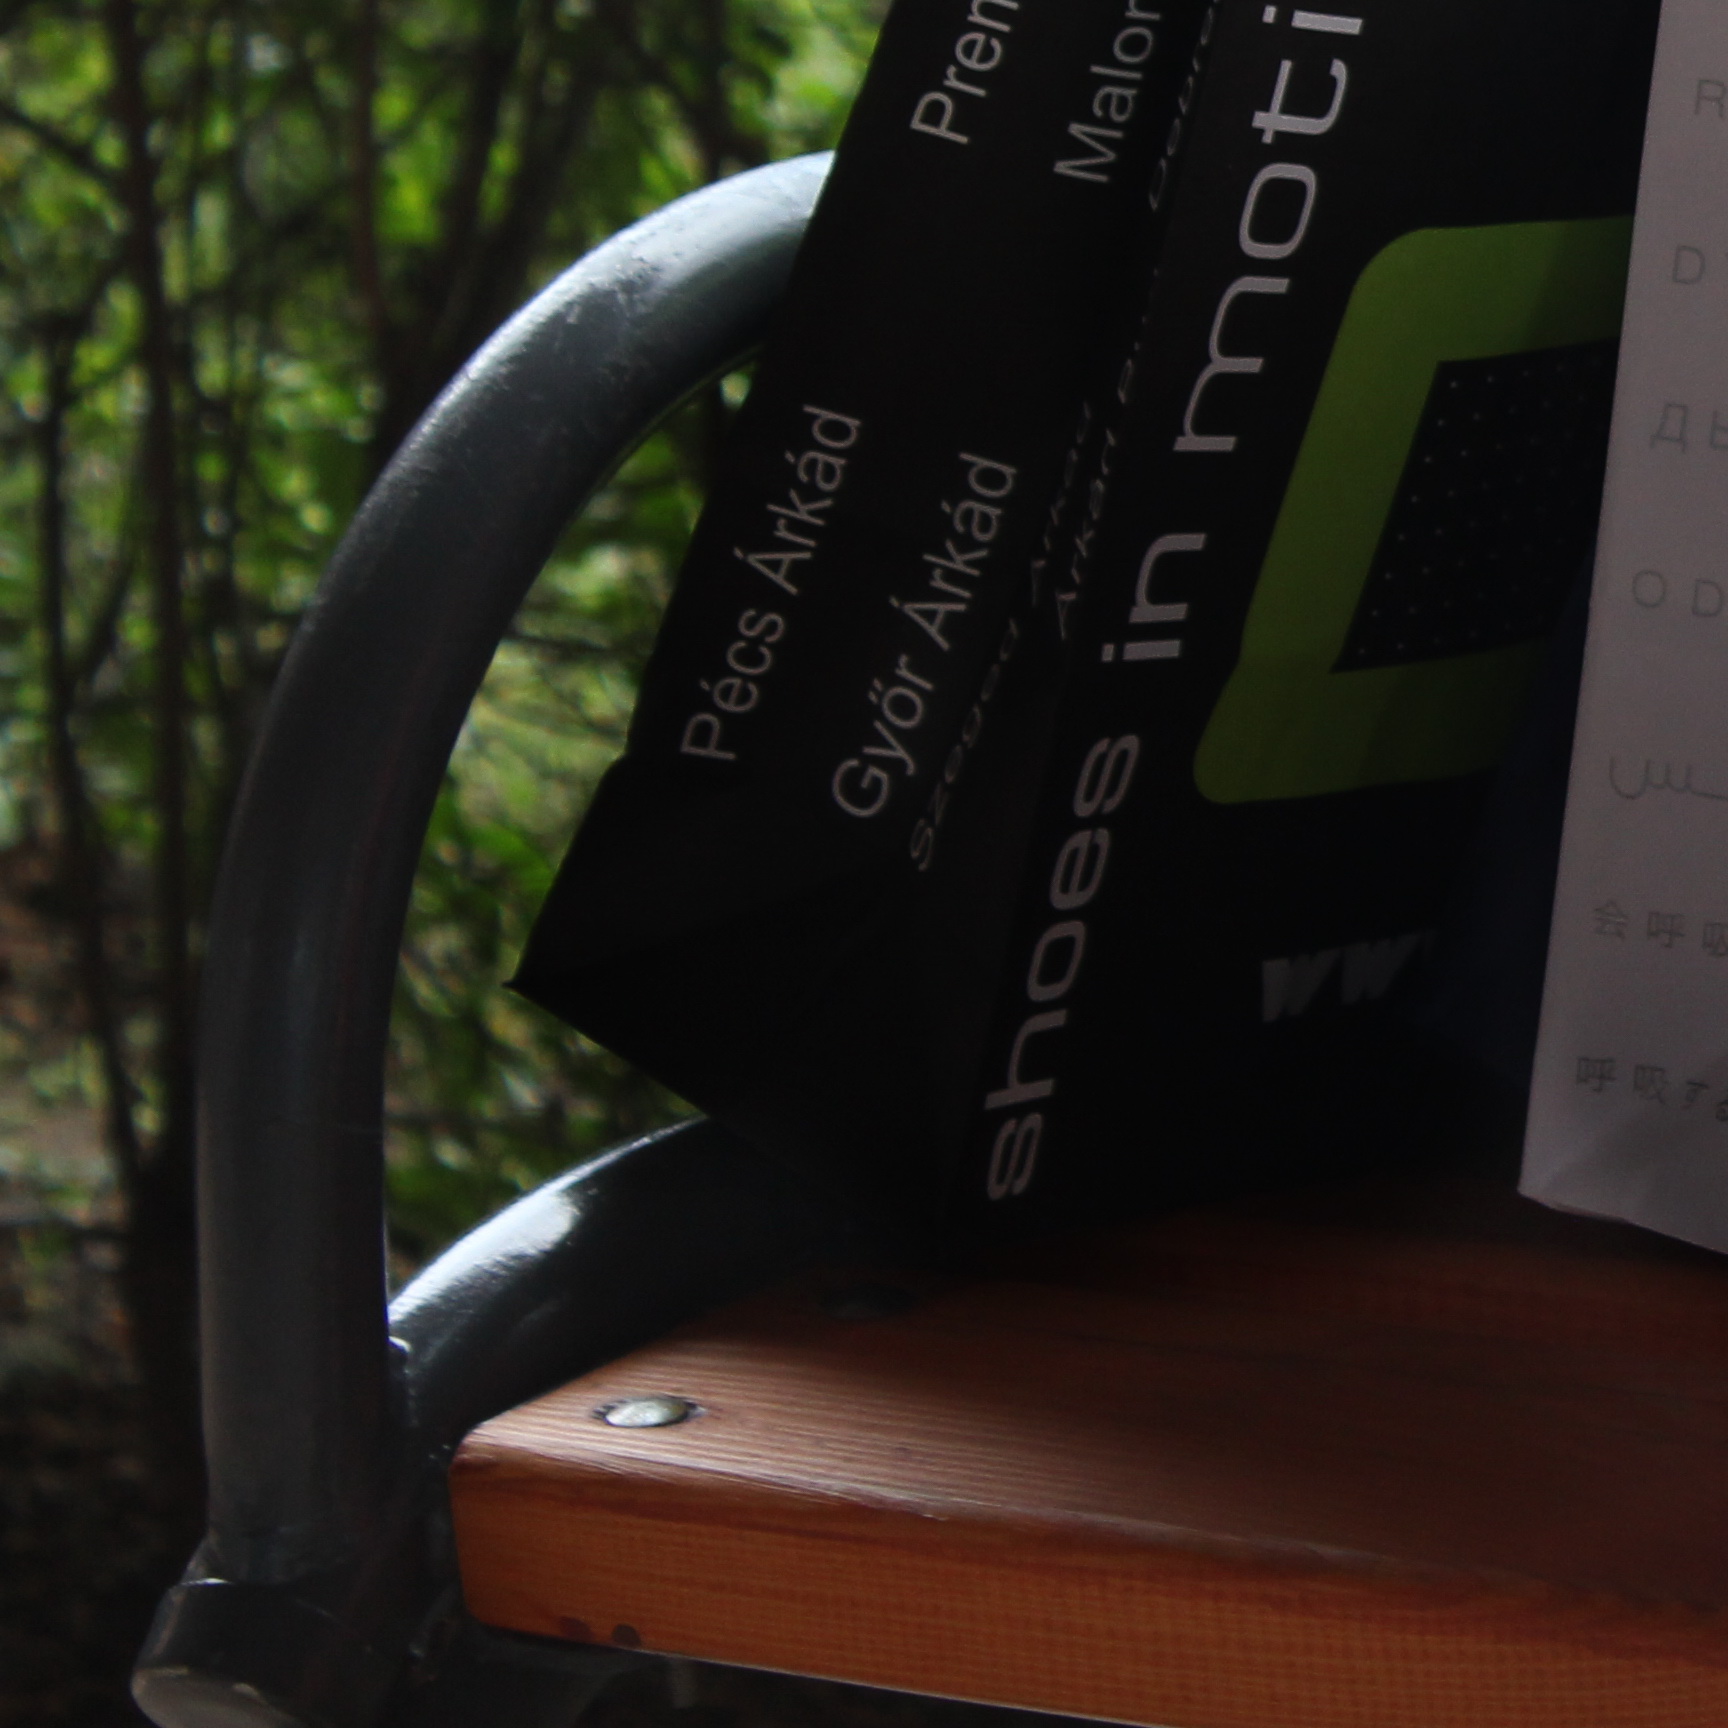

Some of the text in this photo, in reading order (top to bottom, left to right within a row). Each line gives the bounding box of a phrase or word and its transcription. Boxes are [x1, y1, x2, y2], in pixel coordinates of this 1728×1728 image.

[680, 403, 863, 762] Pécs Árkád
[831, 450, 1018, 818] Győr Árkád
[983, 732, 1141, 1201] shoes
[1100, 532, 1209, 664] in
